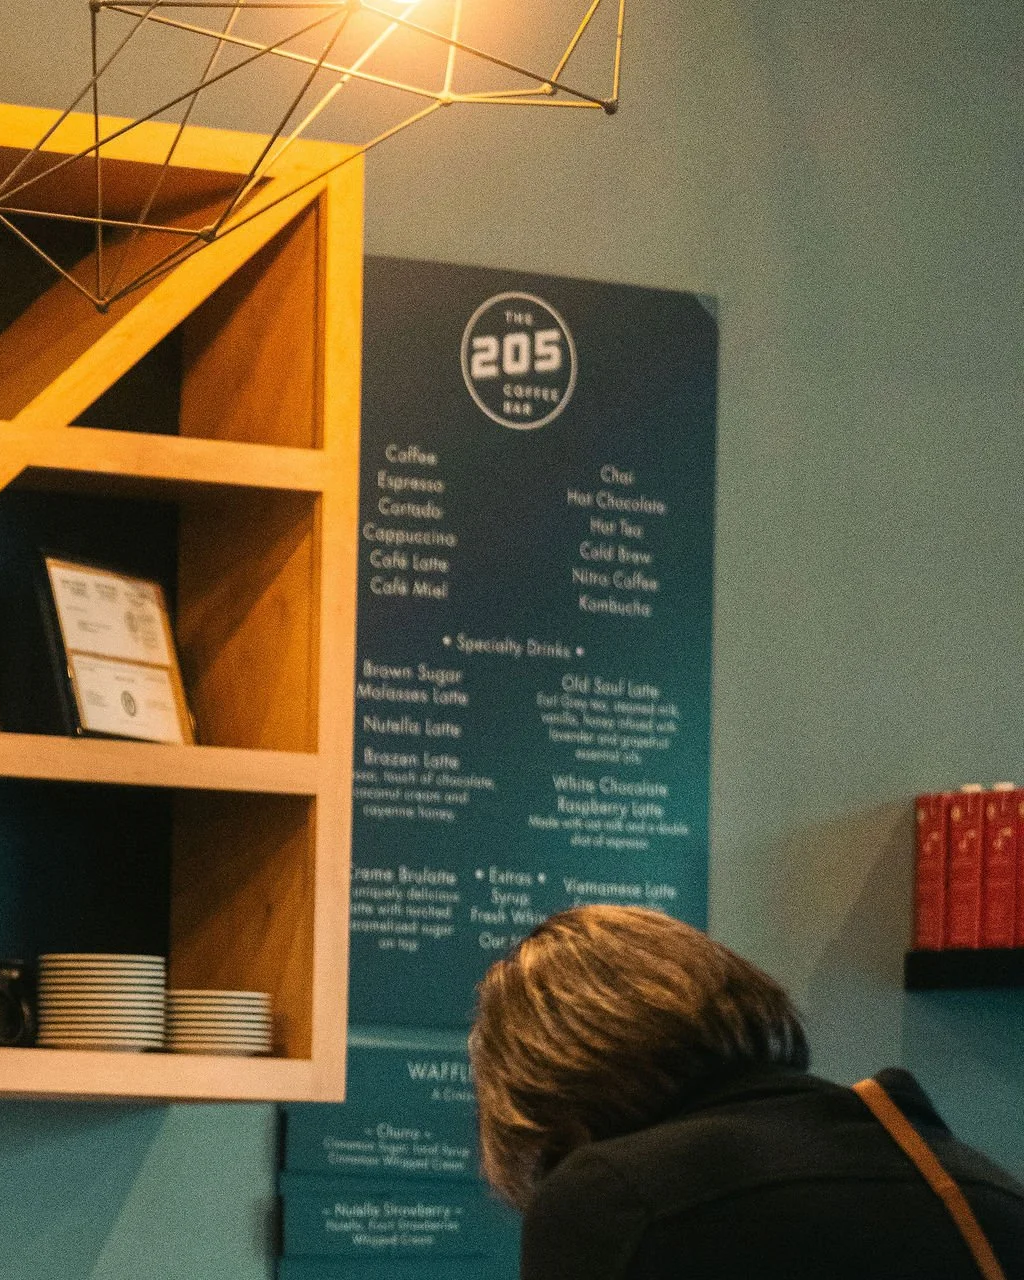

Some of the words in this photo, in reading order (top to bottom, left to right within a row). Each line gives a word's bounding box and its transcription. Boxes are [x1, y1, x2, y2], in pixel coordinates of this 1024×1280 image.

[504, 311, 533, 326] THE
[471, 329, 561, 379] 205
[503, 383, 559, 402] COFFEE
[503, 401, 532, 416] BAR
[385, 444, 437, 465] Coffee
[378, 470, 445, 492] Espresso
[600, 464, 635, 485] Chai
[378, 496, 443, 518] Cortado
[567, 488, 593, 506] Hot
[596, 490, 666, 515] Chocolate
[363, 522, 457, 547] Cappuccino
[590, 515, 616, 535] Hot
[620, 518, 643, 539] Tea
[413, 552, 450, 573] Latte
[579, 540, 615, 561] Cold
[618, 544, 652, 565] Brew
[572, 568, 610, 587] Nitro
[613, 570, 658, 591] Coffee
[579, 593, 652, 617] Kombucha
[457, 632, 523, 659] Specialty
[527, 638, 571, 658] Drinks
[363, 659, 413, 679] Brown
[417, 662, 463, 687] Sugar
[357, 682, 428, 702] Molasses
[433, 687, 469, 706] Latte
[562, 673, 590, 694] Old
[628, 680, 660, 700] Latte
[364, 715, 421, 735] Nutella
[425, 718, 462, 738] Latte
[424, 750, 460, 770] Latte
[353, 787, 401, 800] oconut
[552, 774, 595, 793] White
[599, 776, 668, 797] Chocolate
[557, 795, 628, 818] Raspberry
[632, 801, 665, 818] Latte
[489, 865, 533, 886] Extras
[563, 878, 643, 898] Vietnamese
[645, 881, 677, 900] Latte
